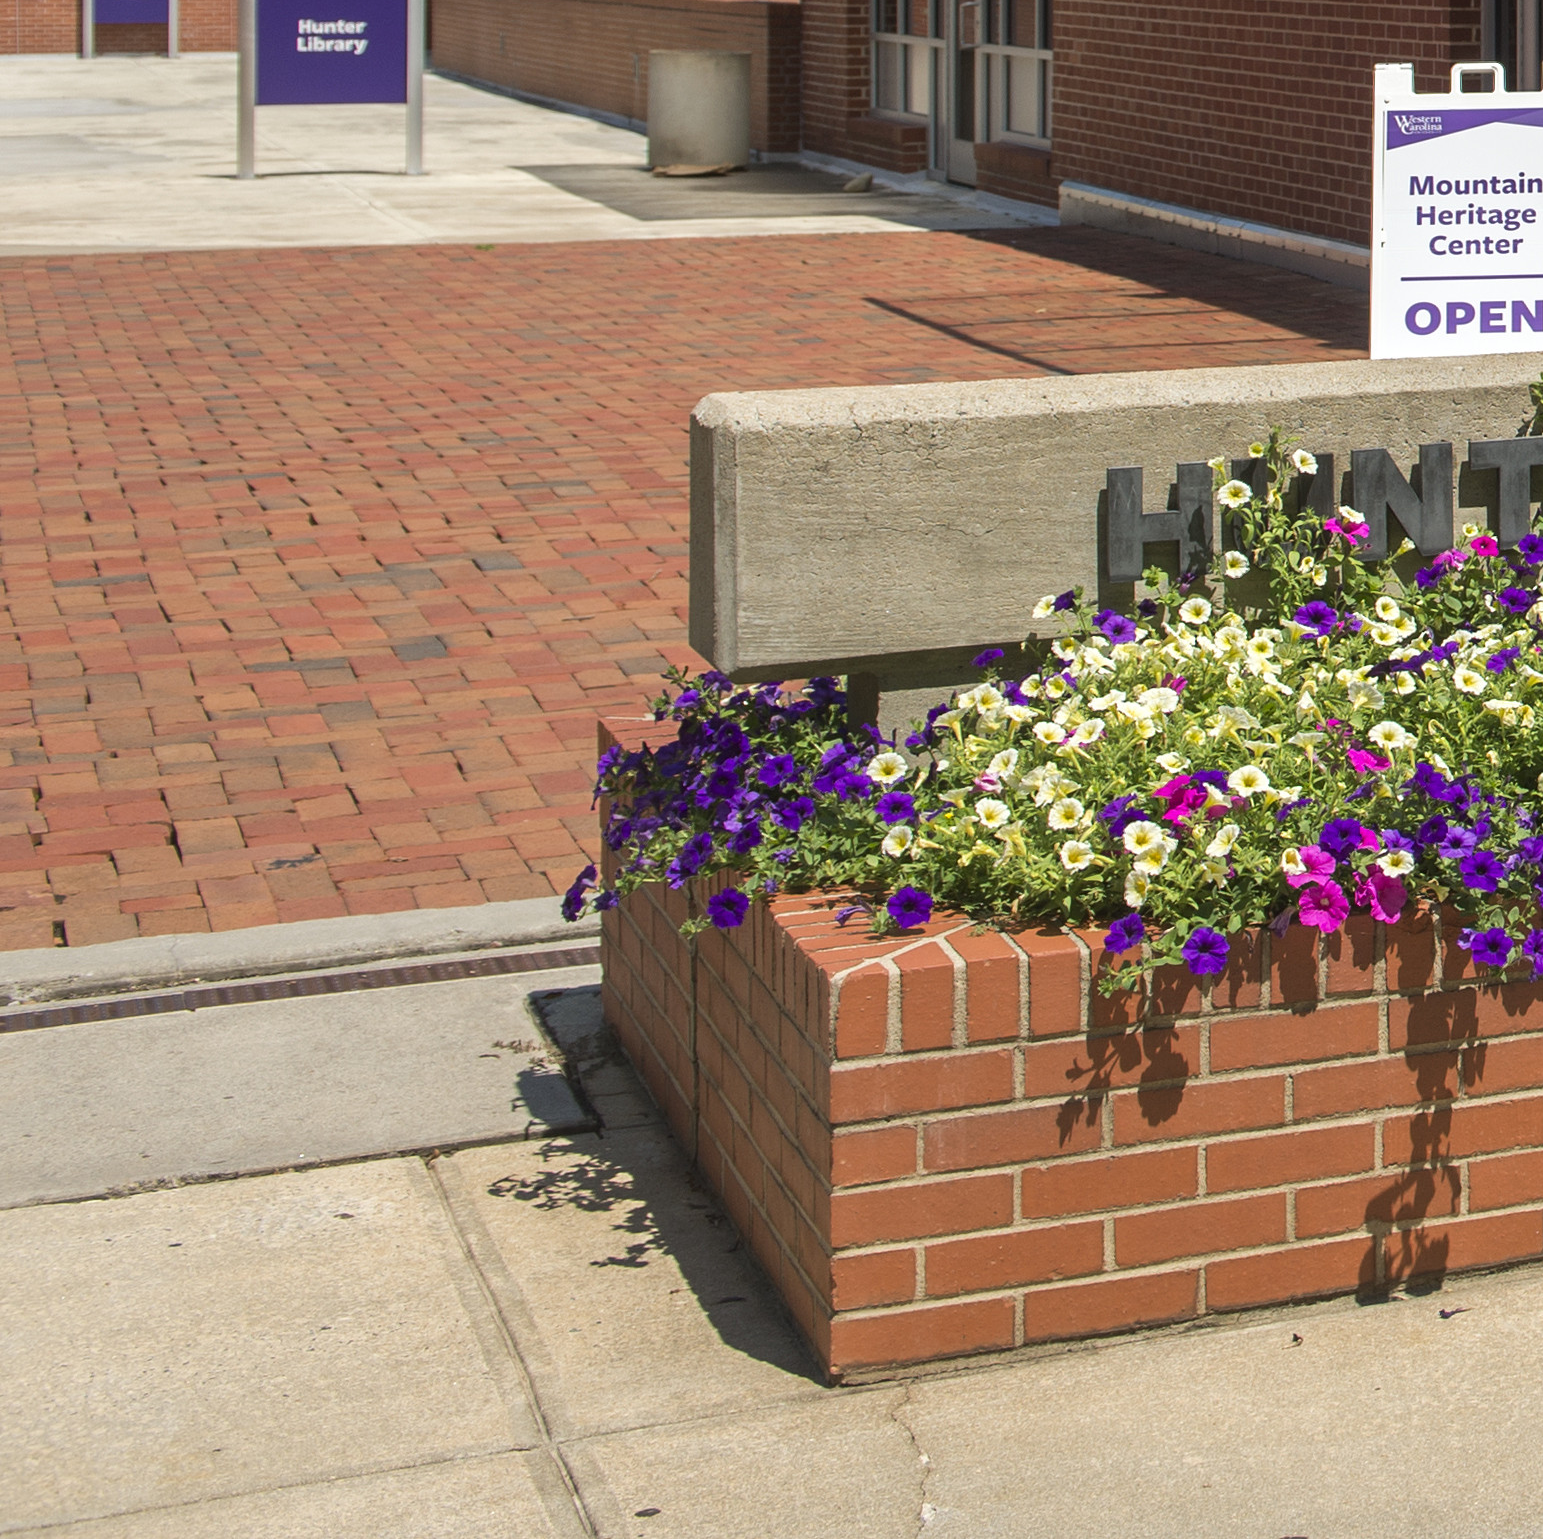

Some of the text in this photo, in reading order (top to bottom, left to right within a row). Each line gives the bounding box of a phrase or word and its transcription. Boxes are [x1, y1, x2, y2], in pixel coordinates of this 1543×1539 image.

[297, 19, 367, 35] Hunter
[296, 37, 368, 55] Library
[1393, 115, 1442, 128] Western
[1401, 123, 1442, 135] Carolina
[1409, 172, 1543, 195] Mountain
[1416, 203, 1537, 231] Heritage
[1429, 235, 1523, 255] Center
